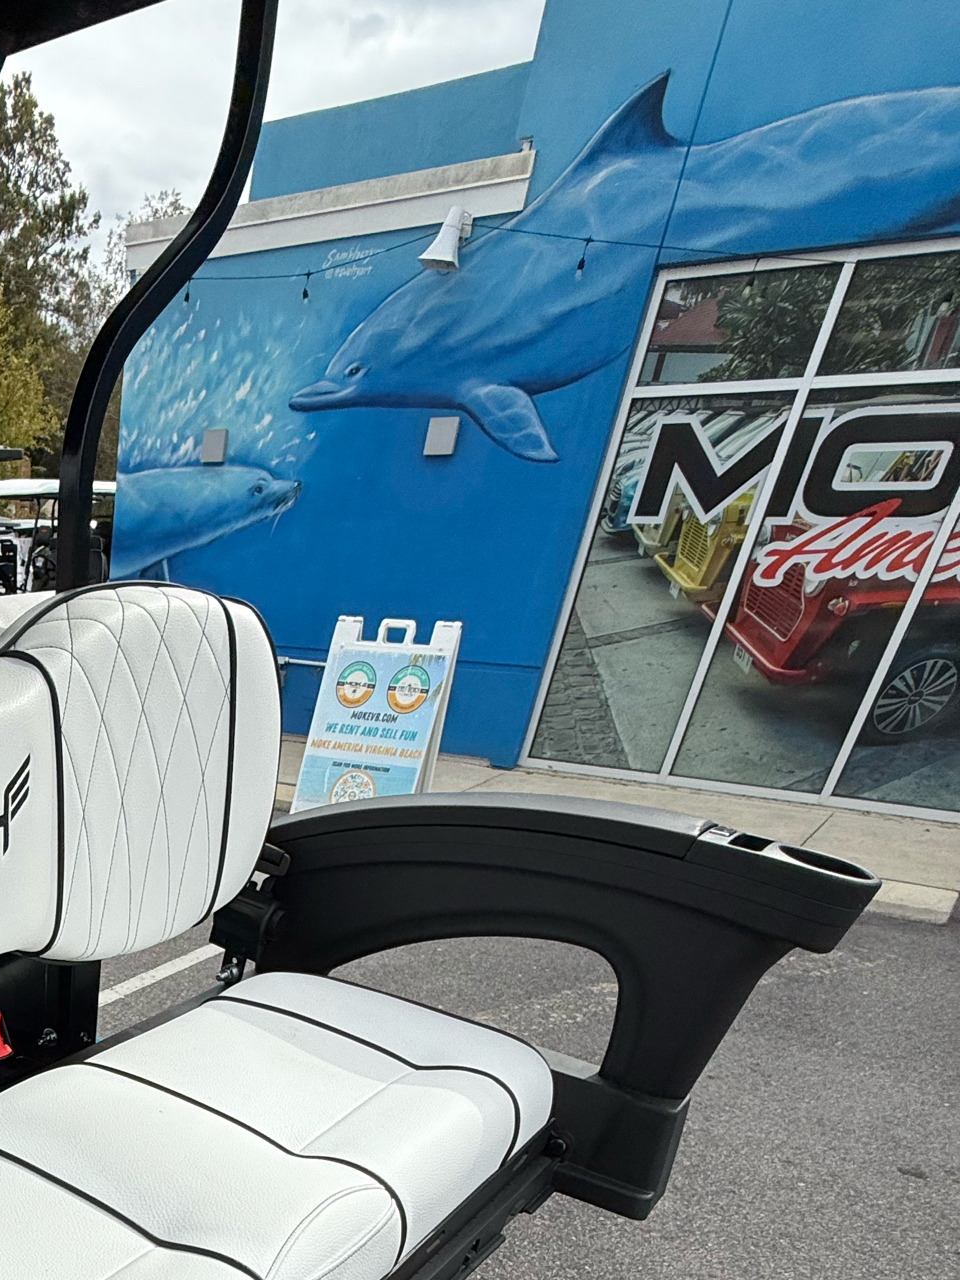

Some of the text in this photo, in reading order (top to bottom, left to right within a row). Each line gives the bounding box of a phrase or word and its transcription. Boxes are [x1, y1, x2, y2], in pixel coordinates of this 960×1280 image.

[350, 710, 400, 724] MOKEVB.COM
[325, 722, 419, 742] WE RENT AND SELL FUN
[310, 738, 424, 759] MOKE AMERICA VIRGINIA BEACH
